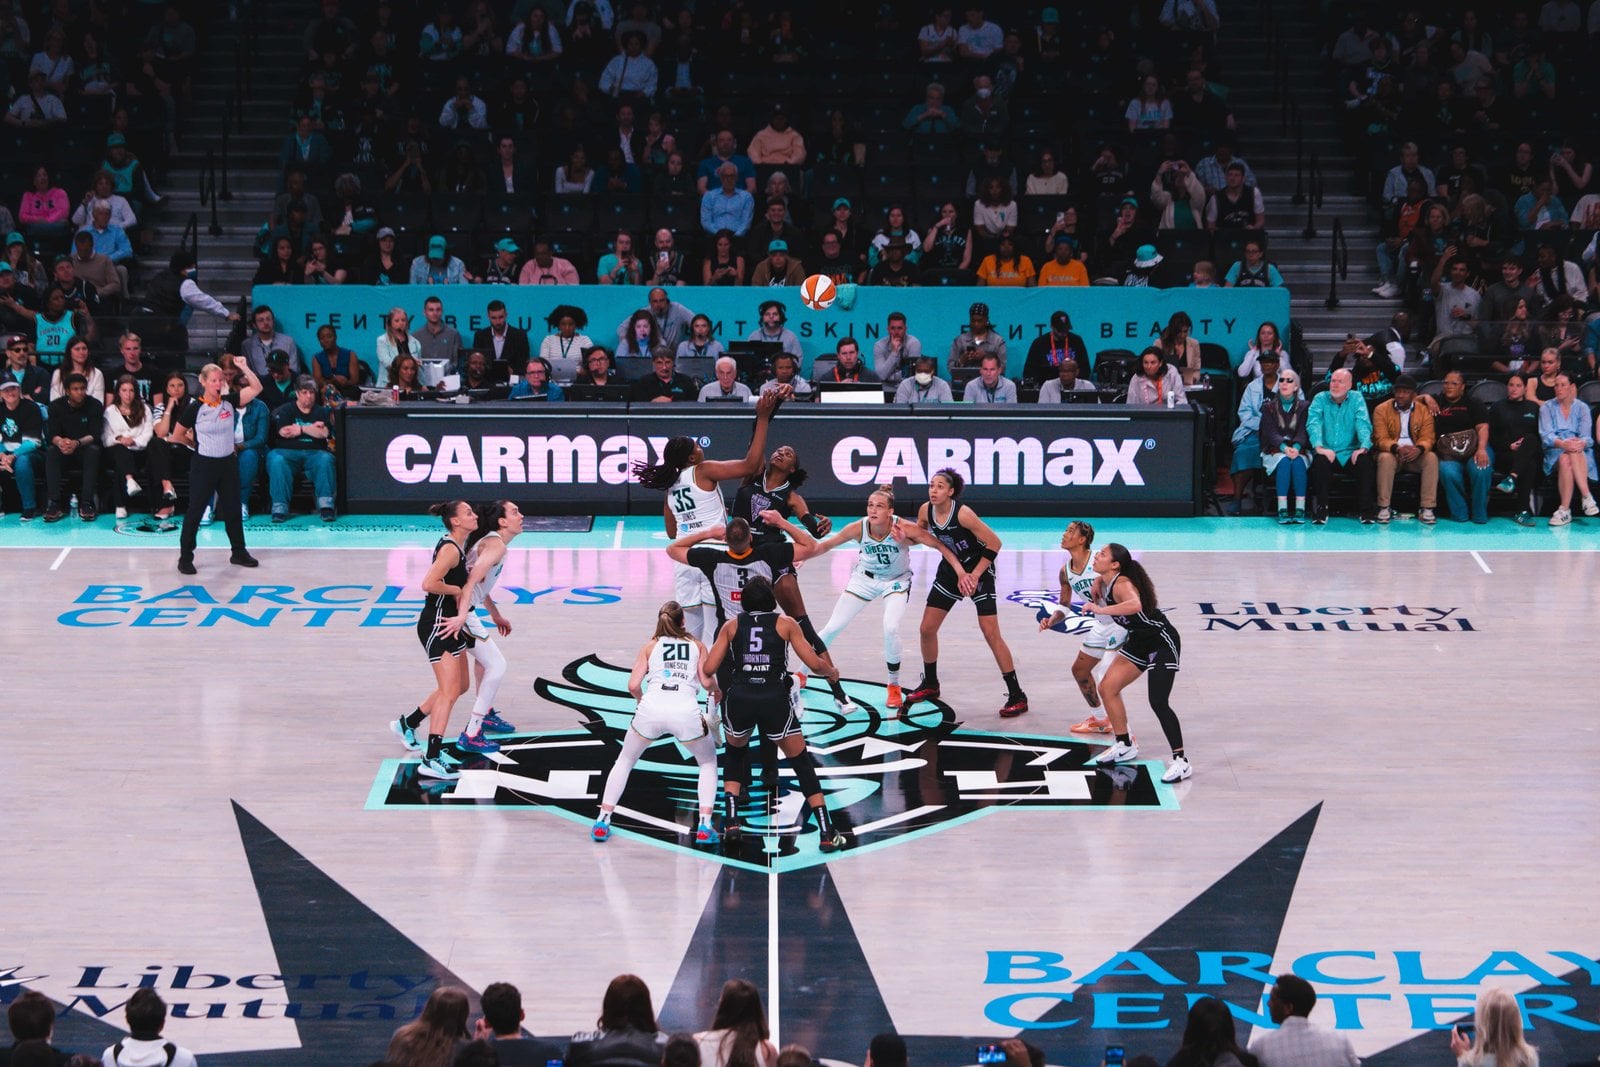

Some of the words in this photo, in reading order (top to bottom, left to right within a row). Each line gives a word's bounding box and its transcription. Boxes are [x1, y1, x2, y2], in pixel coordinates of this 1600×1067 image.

[800, 321, 880, 339] SKIN
[1100, 318, 1236, 339] BEATY
[672, 487, 696, 513] 35
[864, 543, 899, 555] LIBERTY
[955, 540, 969, 551] 13
[876, 553, 891, 565] 13
[737, 568, 749, 589] 3
[73, 585, 624, 605] BARCLYS
[1196, 602, 1459, 622] Liberty
[1204, 617, 1481, 632] Mutual
[749, 626, 763, 652] 5
[662, 643, 690, 661] 20
[742, 653, 770, 663] THORNTON
[664, 661, 689, 671] IONESCU
[671, 672, 689, 680] AT&T
[73, 965, 437, 1000] Liberty
